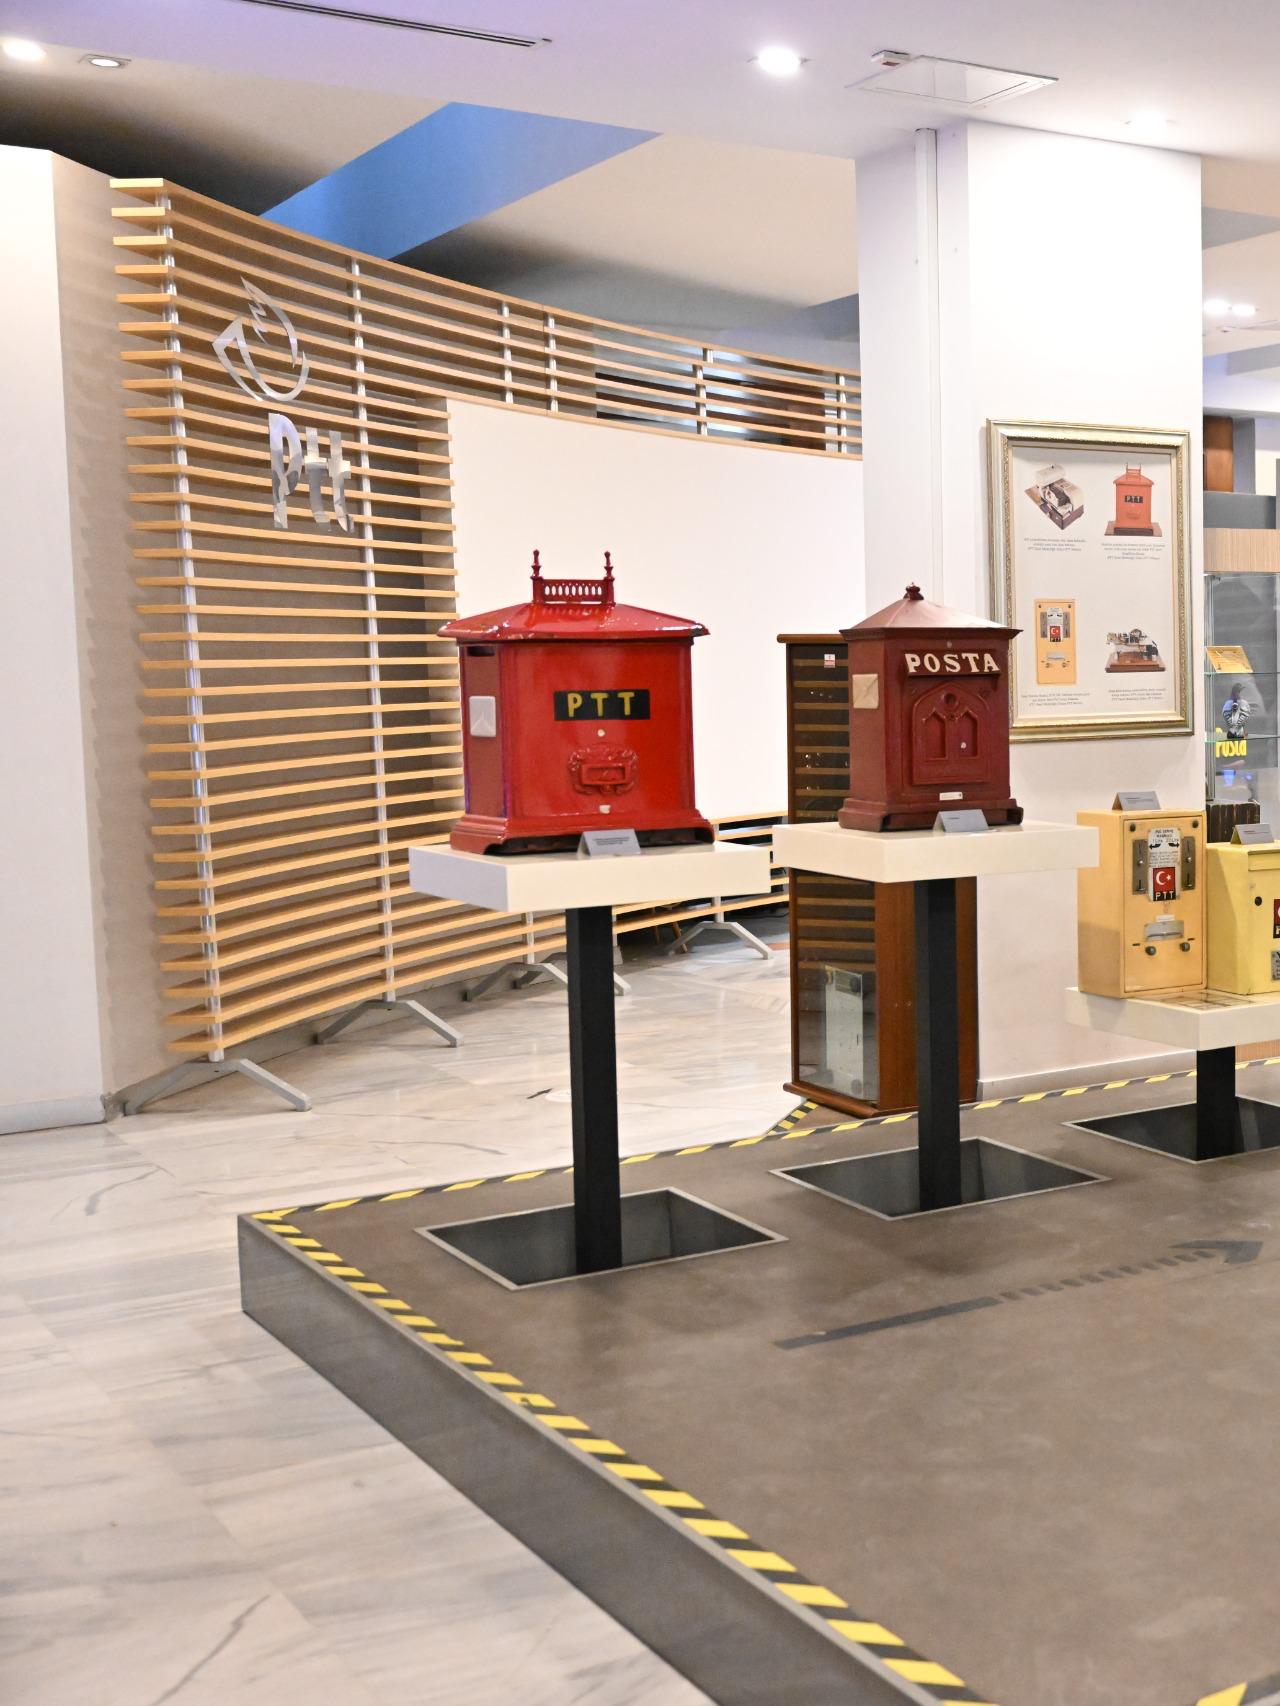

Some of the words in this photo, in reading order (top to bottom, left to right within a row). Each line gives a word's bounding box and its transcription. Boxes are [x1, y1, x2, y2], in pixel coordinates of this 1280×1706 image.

[904, 653, 1000, 673] POSTA
[567, 692, 635, 717] PTT
[1155, 890, 1174, 901] PTT
